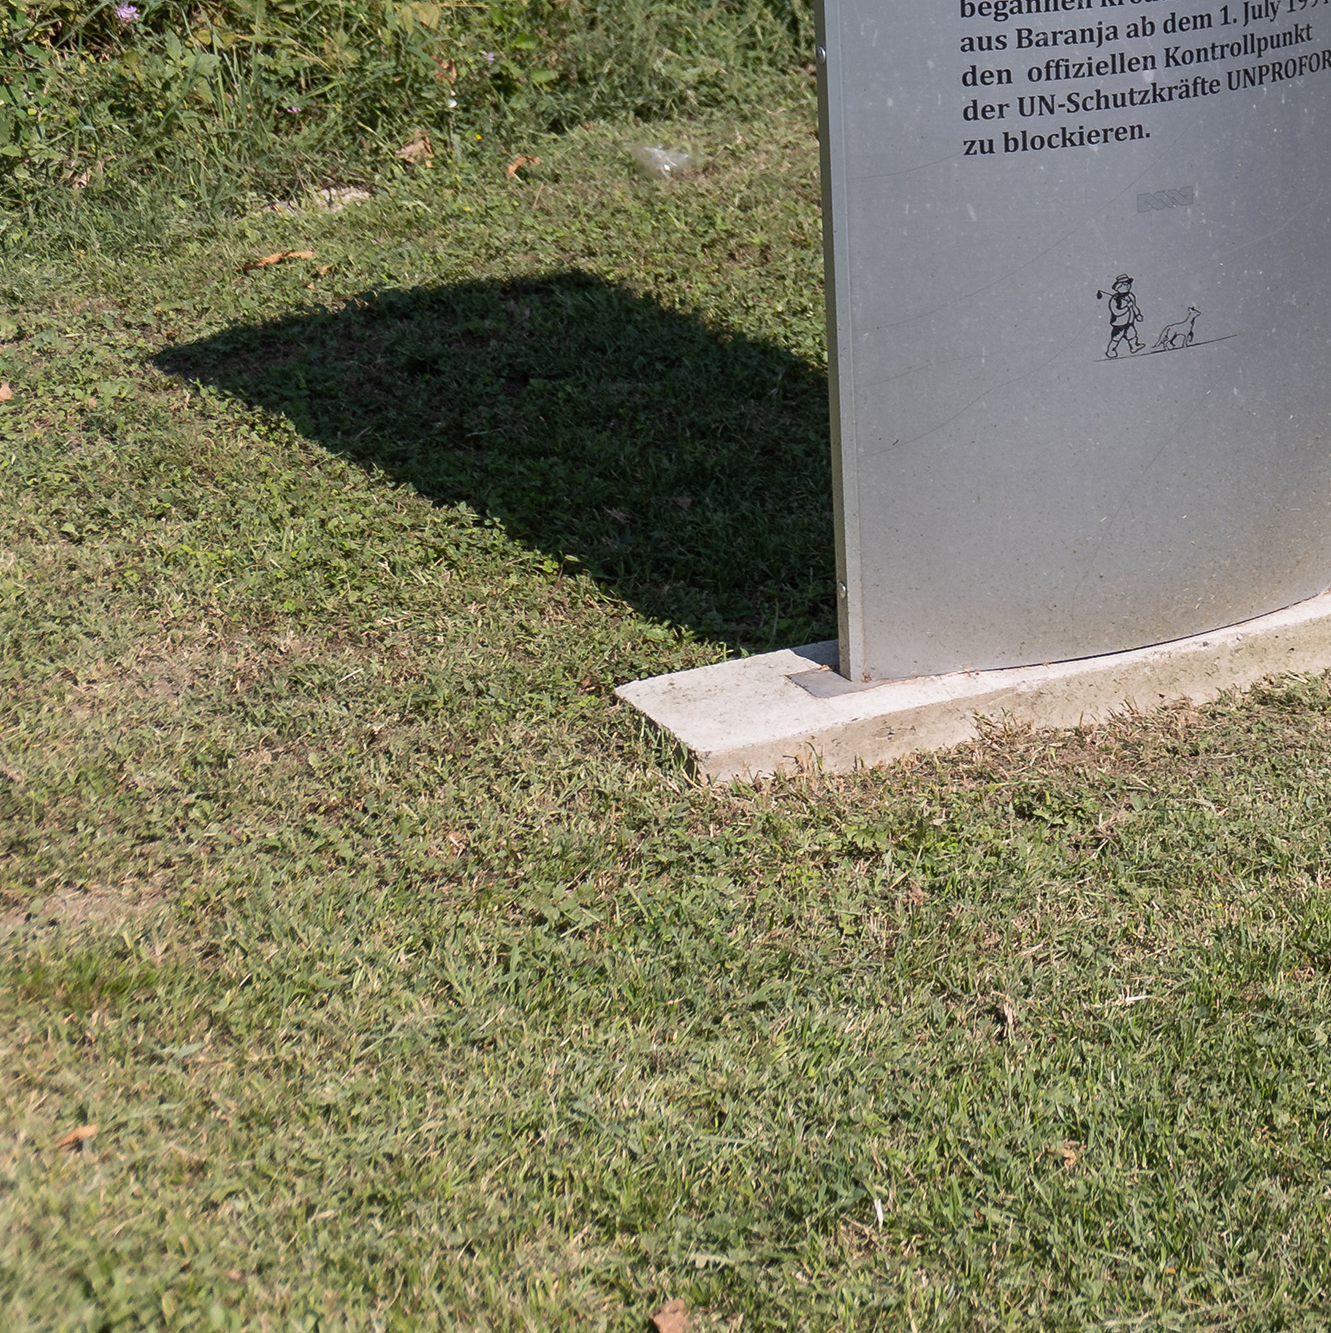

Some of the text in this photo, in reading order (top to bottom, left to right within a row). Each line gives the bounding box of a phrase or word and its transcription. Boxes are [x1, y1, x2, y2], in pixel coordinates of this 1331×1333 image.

[960, 34, 1008, 53] aus
[1015, 20, 1120, 50] Baranja
[1125, 15, 1156, 39] ab
[1162, 11, 1213, 35] dem
[1219, 4, 1238, 26] 1.
[961, 22, 1314, 88] den offiziellen Kontrollpunkt
[962, 99, 1011, 122] der
[1016, 75, 1221, 118] UN-Schutzkräfte
[963, 123, 1151, 156] zu blockieren.
